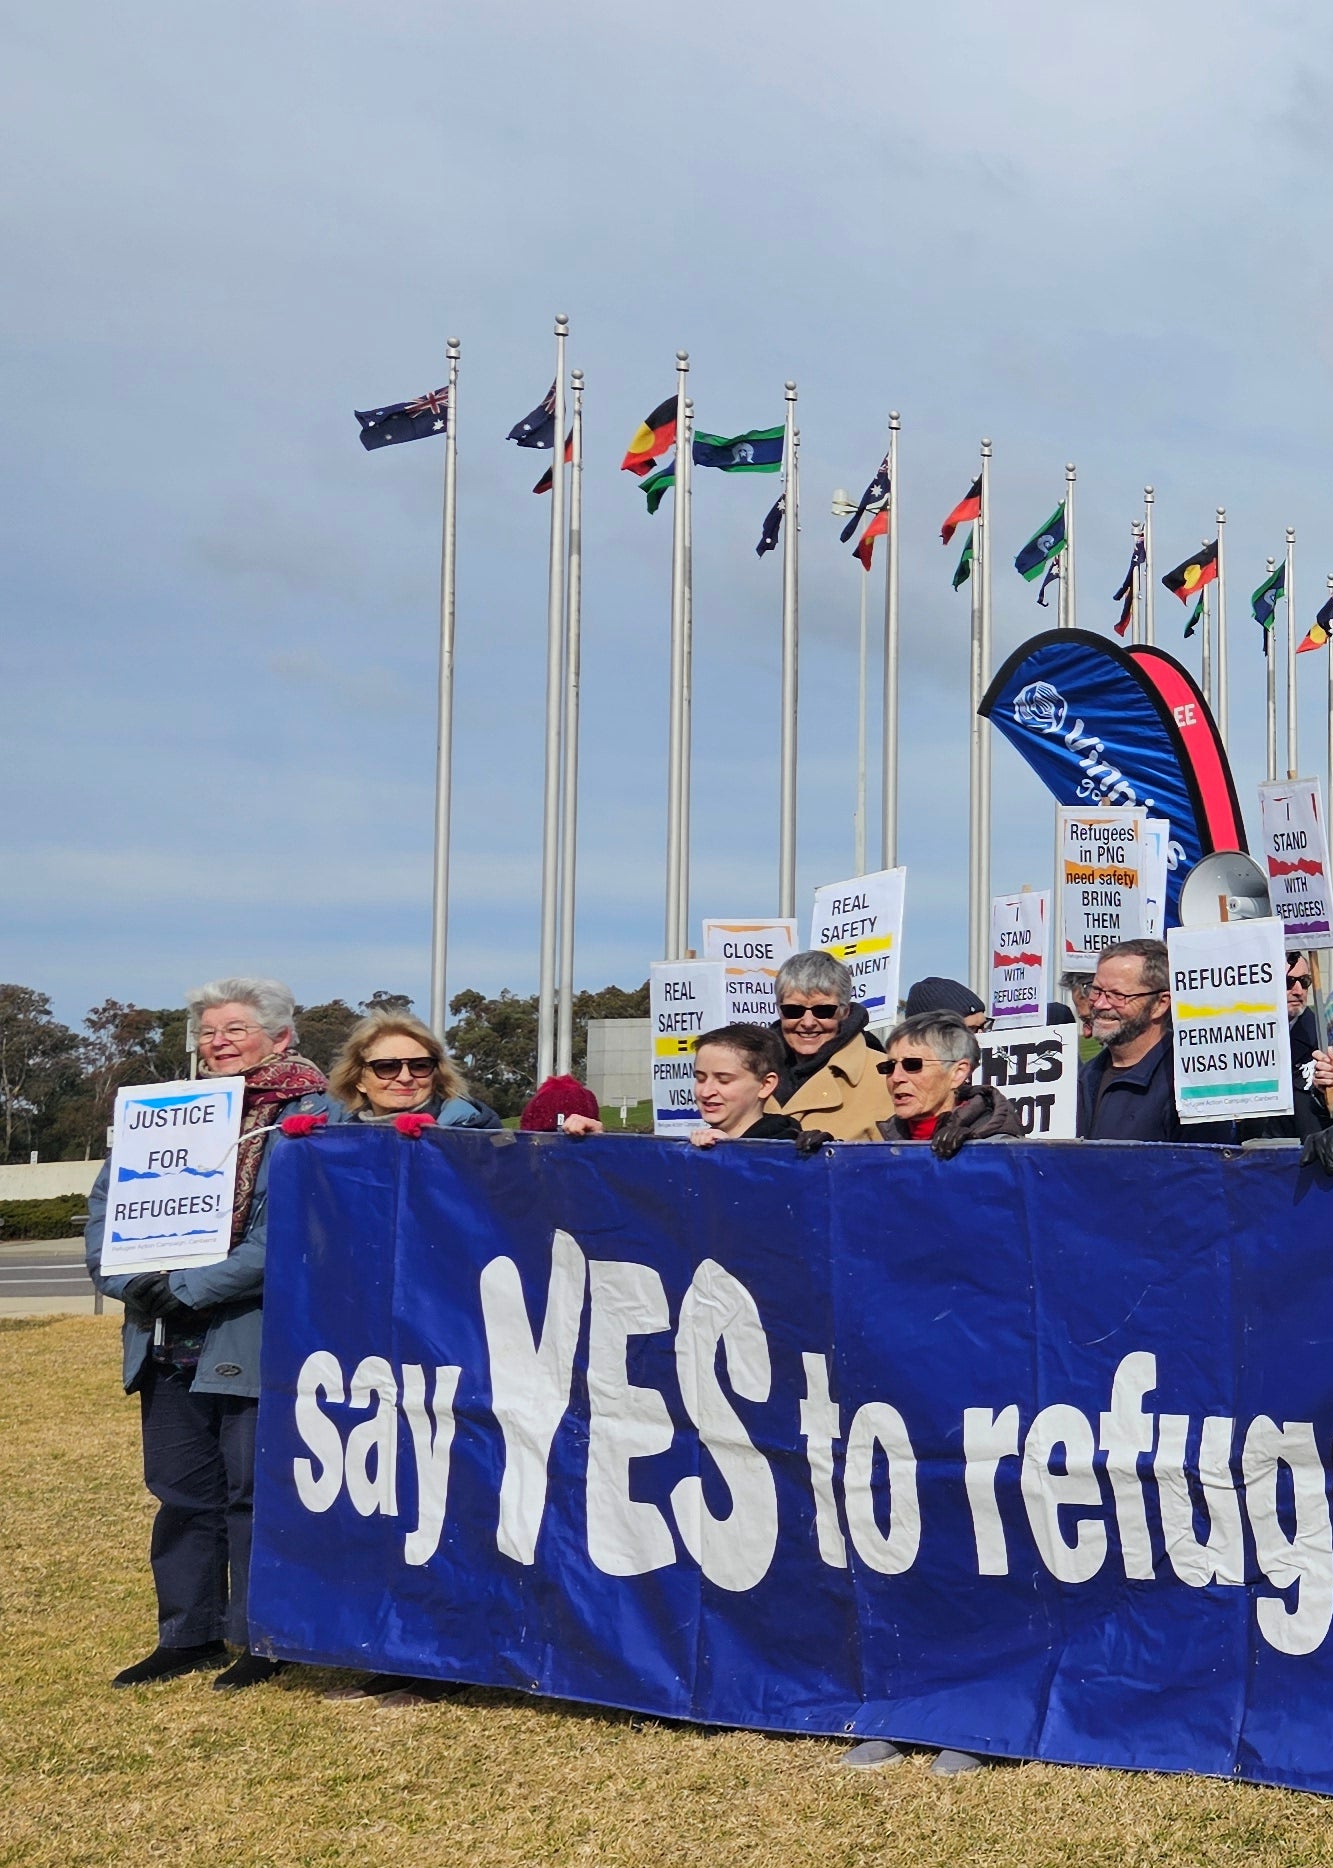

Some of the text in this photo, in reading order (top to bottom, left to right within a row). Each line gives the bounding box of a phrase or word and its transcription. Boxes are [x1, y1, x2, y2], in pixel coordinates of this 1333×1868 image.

[1286, 802, 1290, 821] I
[1070, 823, 1135, 845] Refugees
[1273, 831, 1307, 852] STAND
[1079, 845, 1125, 864] in PNG
[1066, 870, 1135, 889] need safety
[1284, 876, 1308, 894] WITH
[831, 893, 870, 916] REAL
[1082, 890, 1121, 907] BRING
[1015, 907, 1020, 922] I
[1276, 900, 1325, 920] REFUGEES!
[820, 915, 878, 944] SAFETY
[1084, 913, 1120, 929] THEM
[1000, 929, 1031, 948] STAND
[723, 943, 774, 959] CLOSE
[848, 955, 890, 978] ANENT
[1004, 967, 1025, 982] WITH
[1175, 962, 1273, 991] REFUGEES
[664, 981, 695, 1001] REAL
[993, 986, 1037, 1003] REFUGEES!
[732, 1001, 776, 1014] NAURU
[658, 1011, 704, 1032] SAFETY
[1178, 1021, 1276, 1047] PERMANENT
[981, 1039, 1063, 1087] HIS
[1181, 1050, 1276, 1074] VISAS NOW!
[669, 1089, 696, 1105] VISA
[129, 1104, 216, 1130] JUSTICE
[1007, 1093, 1055, 1135] OT
[147, 1148, 189, 1170] FOR
[114, 1194, 221, 1222] REFUGEES!
[294, 1350, 462, 1566] say
[479, 1229, 779, 1592] YES
[799, 1352, 922, 1575] to
